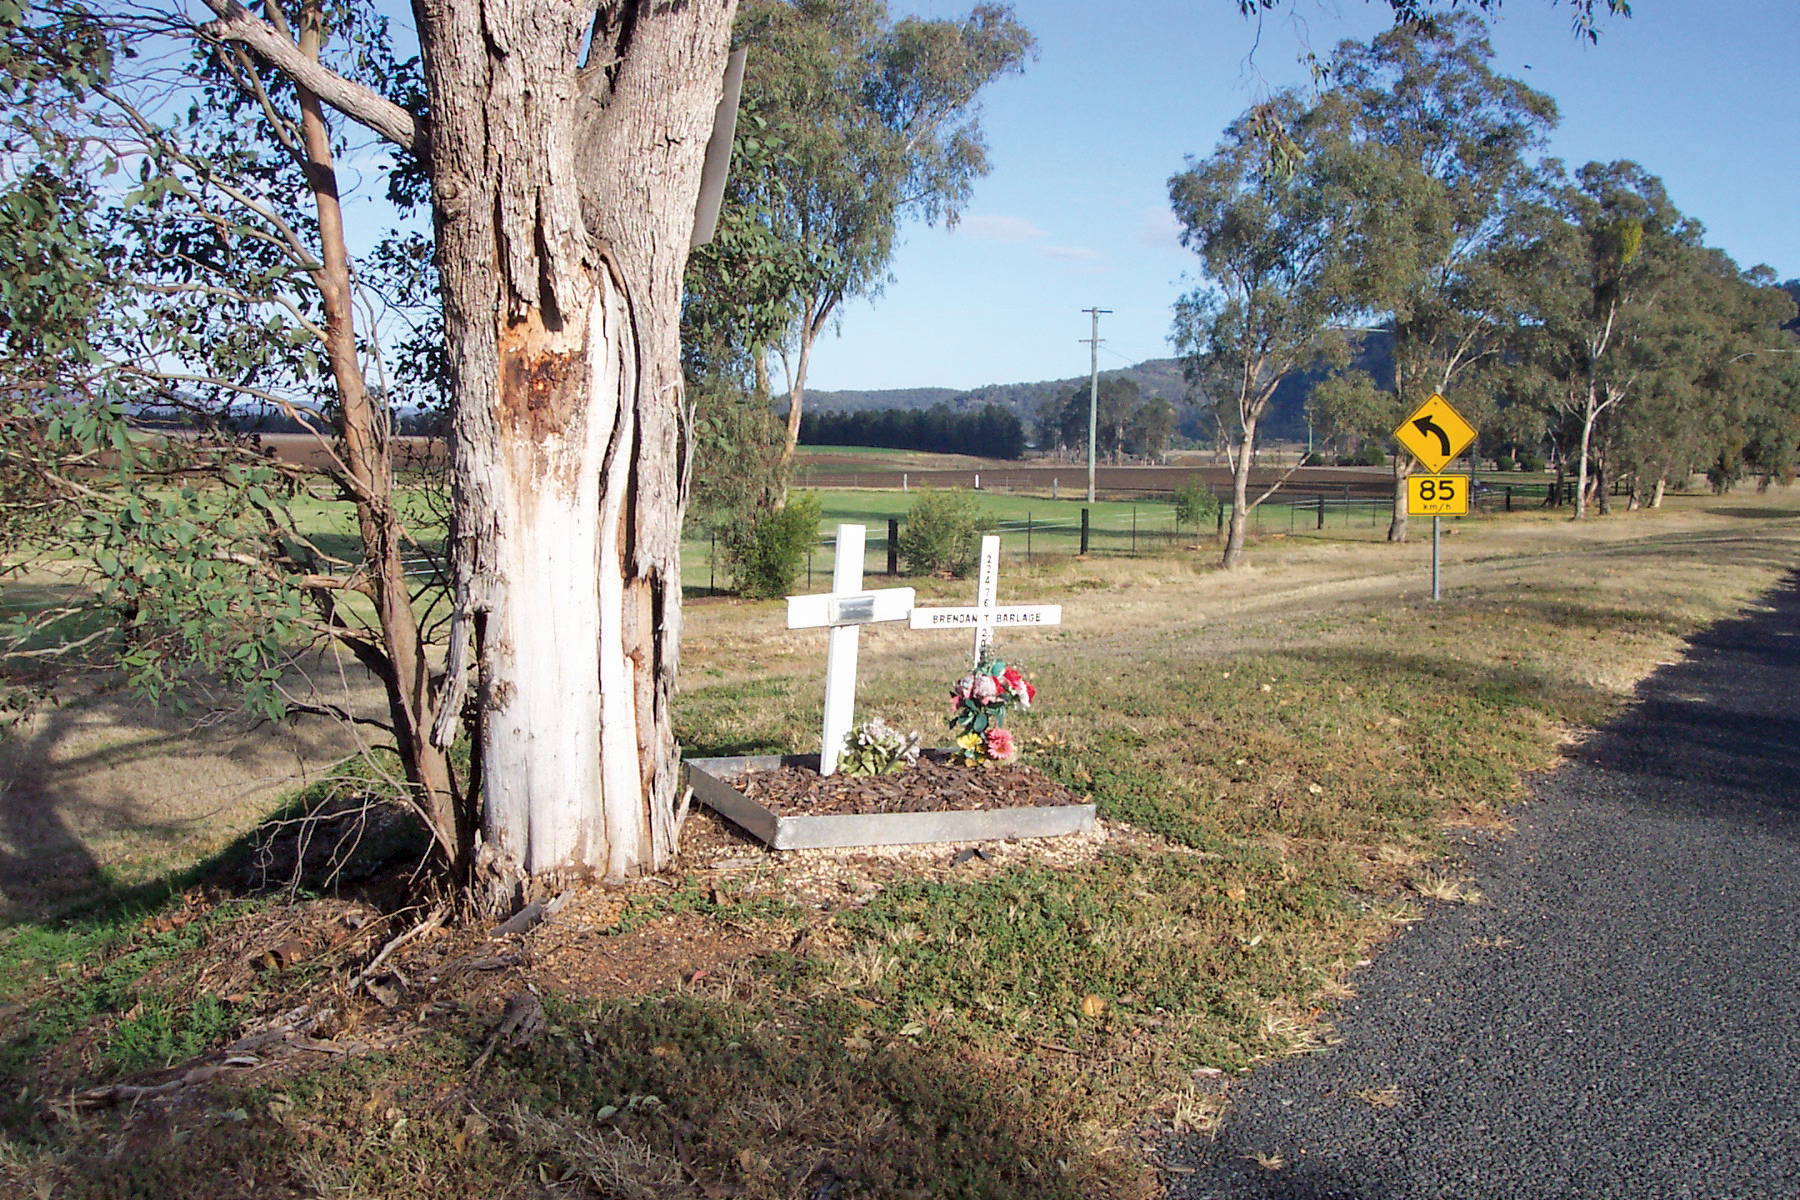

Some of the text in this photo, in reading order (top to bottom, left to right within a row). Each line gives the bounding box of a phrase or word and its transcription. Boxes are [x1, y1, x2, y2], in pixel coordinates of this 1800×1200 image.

[1420, 480, 1455, 501] 85
[1423, 503, 1452, 512] km/h
[933, 613, 1041, 624] BRENDAN T BARLAGE
